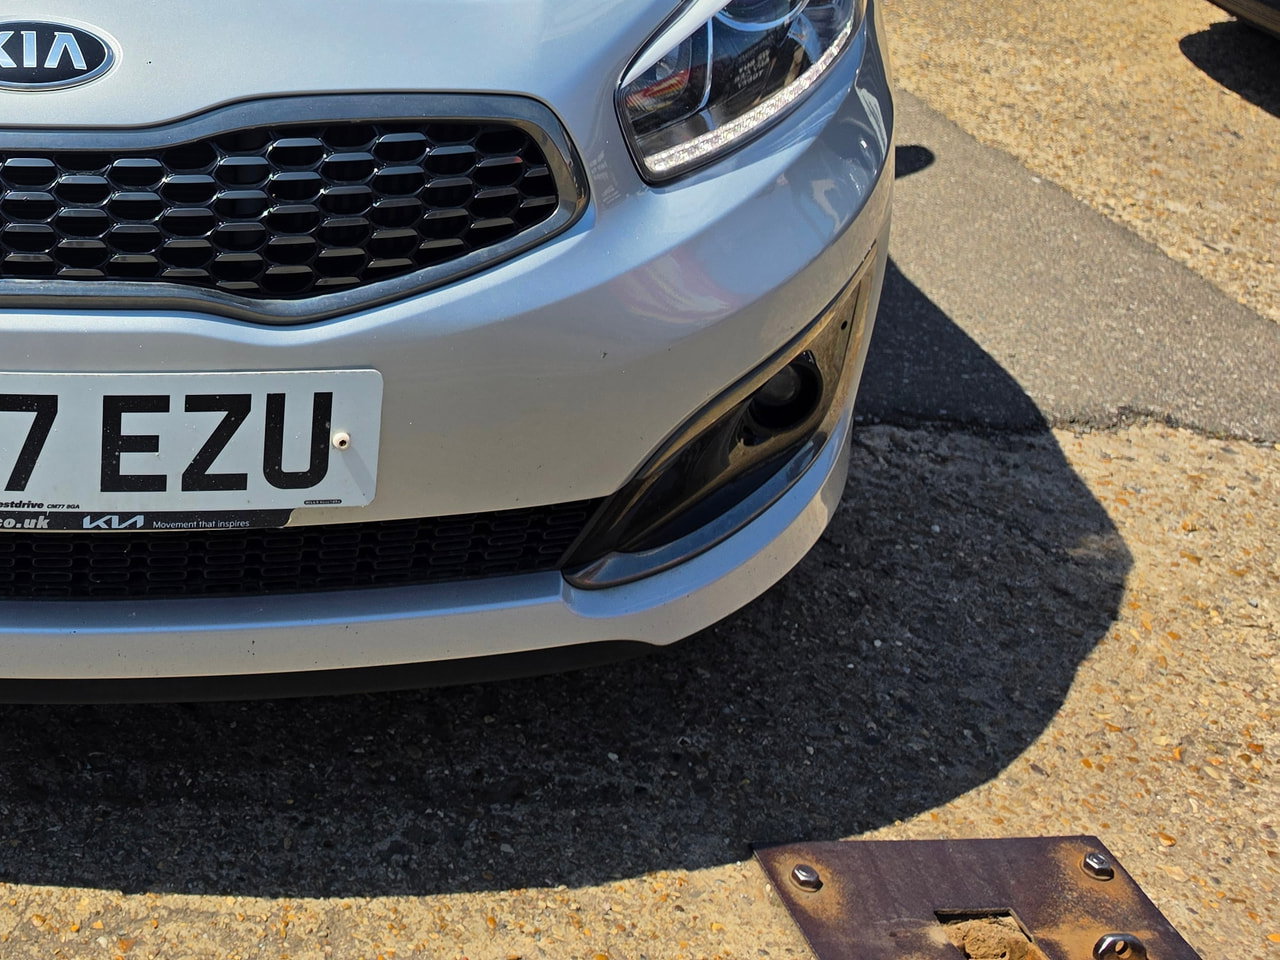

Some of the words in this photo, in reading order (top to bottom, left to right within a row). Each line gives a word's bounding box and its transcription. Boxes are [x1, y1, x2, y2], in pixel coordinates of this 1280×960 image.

[100, 391, 334, 494] EZU
[152, 520, 197, 529] Movement
[199, 520, 215, 528] that
[217, 519, 250, 529] inspires
